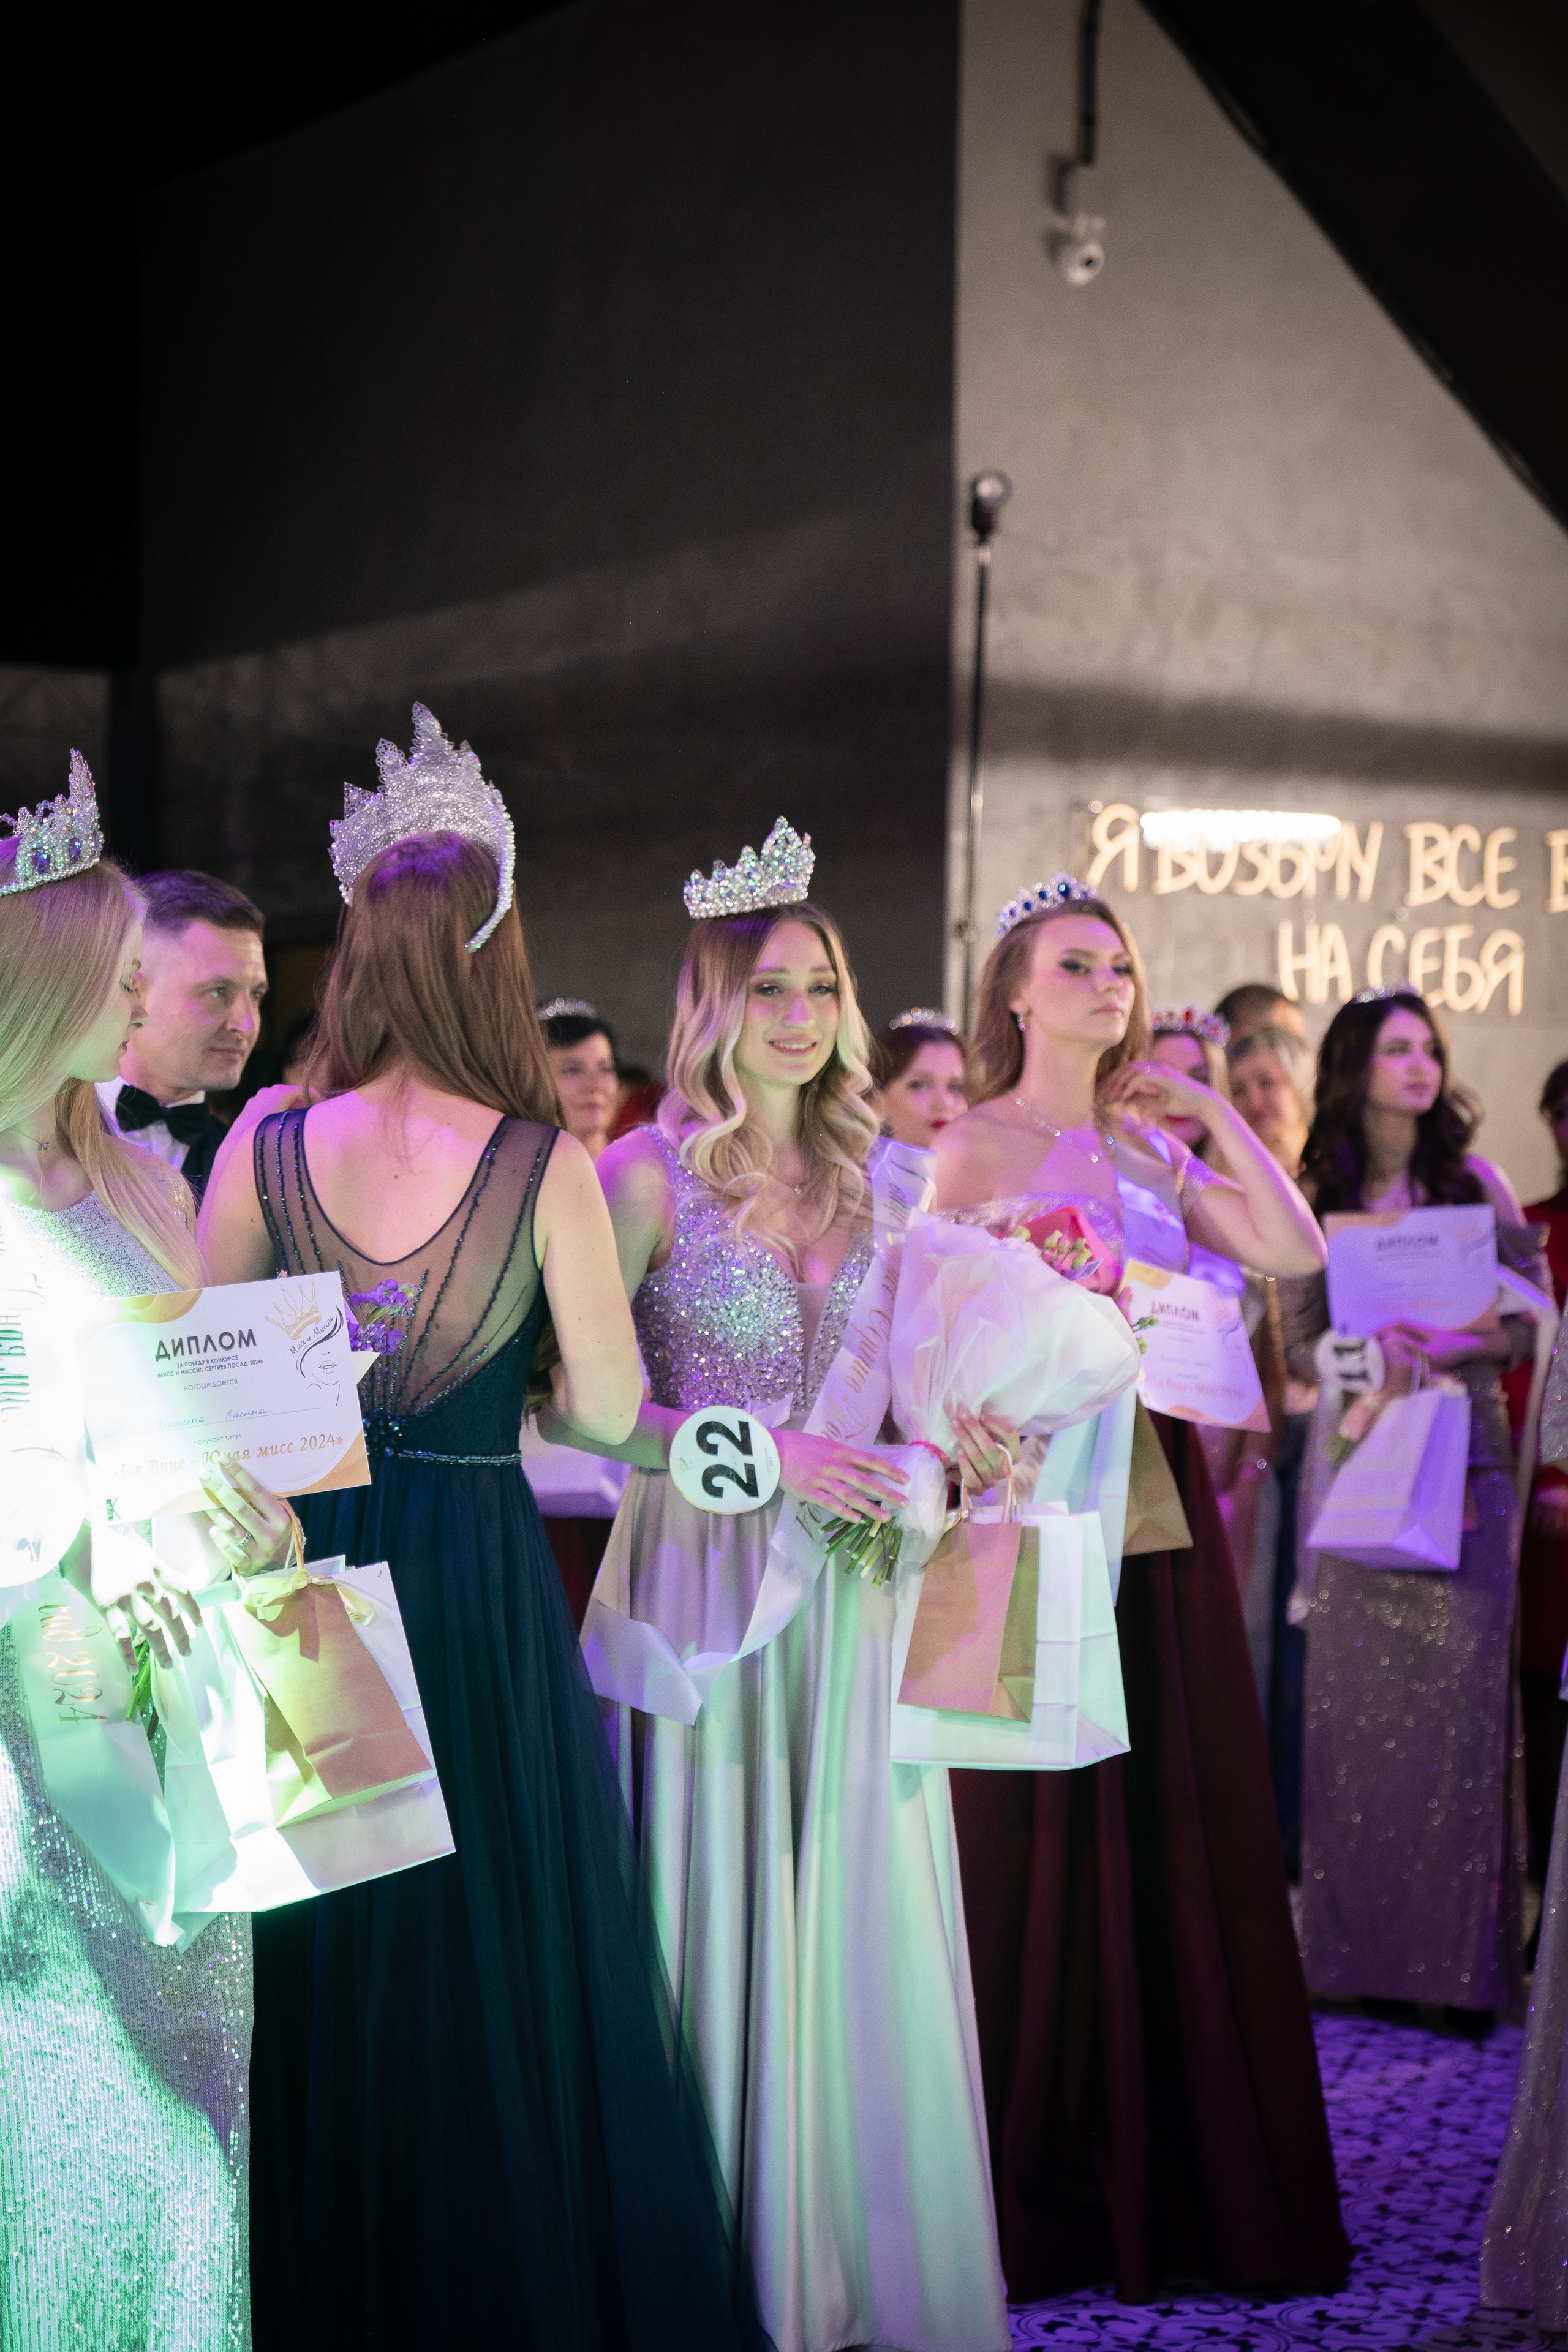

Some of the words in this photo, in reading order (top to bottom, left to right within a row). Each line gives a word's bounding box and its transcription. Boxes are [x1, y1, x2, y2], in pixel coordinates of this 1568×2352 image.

[1085, 804, 1140, 892] Я
[1403, 822, 1523, 910] ВСЕ
[1279, 919, 1352, 1006] НА
[1368, 923, 1525, 1017] СЕБЯ
[155, 1329, 257, 1362] ДИПЛОМ
[290, 1339, 307, 1357] Мисс
[313, 1316, 333, 1338] Миссис
[180, 1366, 204, 1375] МИССИС
[205, 1363, 227, 1372] СЕРГИЕВ
[228, 1361, 248, 1370] ПОСАД
[211, 1355, 238, 1364] КОНКУРСЕ
[184, 1379, 238, 1392] награждается
[194, 1436, 225, 1446] получает
[226, 1433, 243, 1442] титул
[256, 1442, 294, 1458] мисс
[300, 1433, 344, 1452] 2024»
[696, 1420, 760, 1499] 22
[38, 1604, 102, 1643] сад
[46, 1651, 107, 1725] 2024
